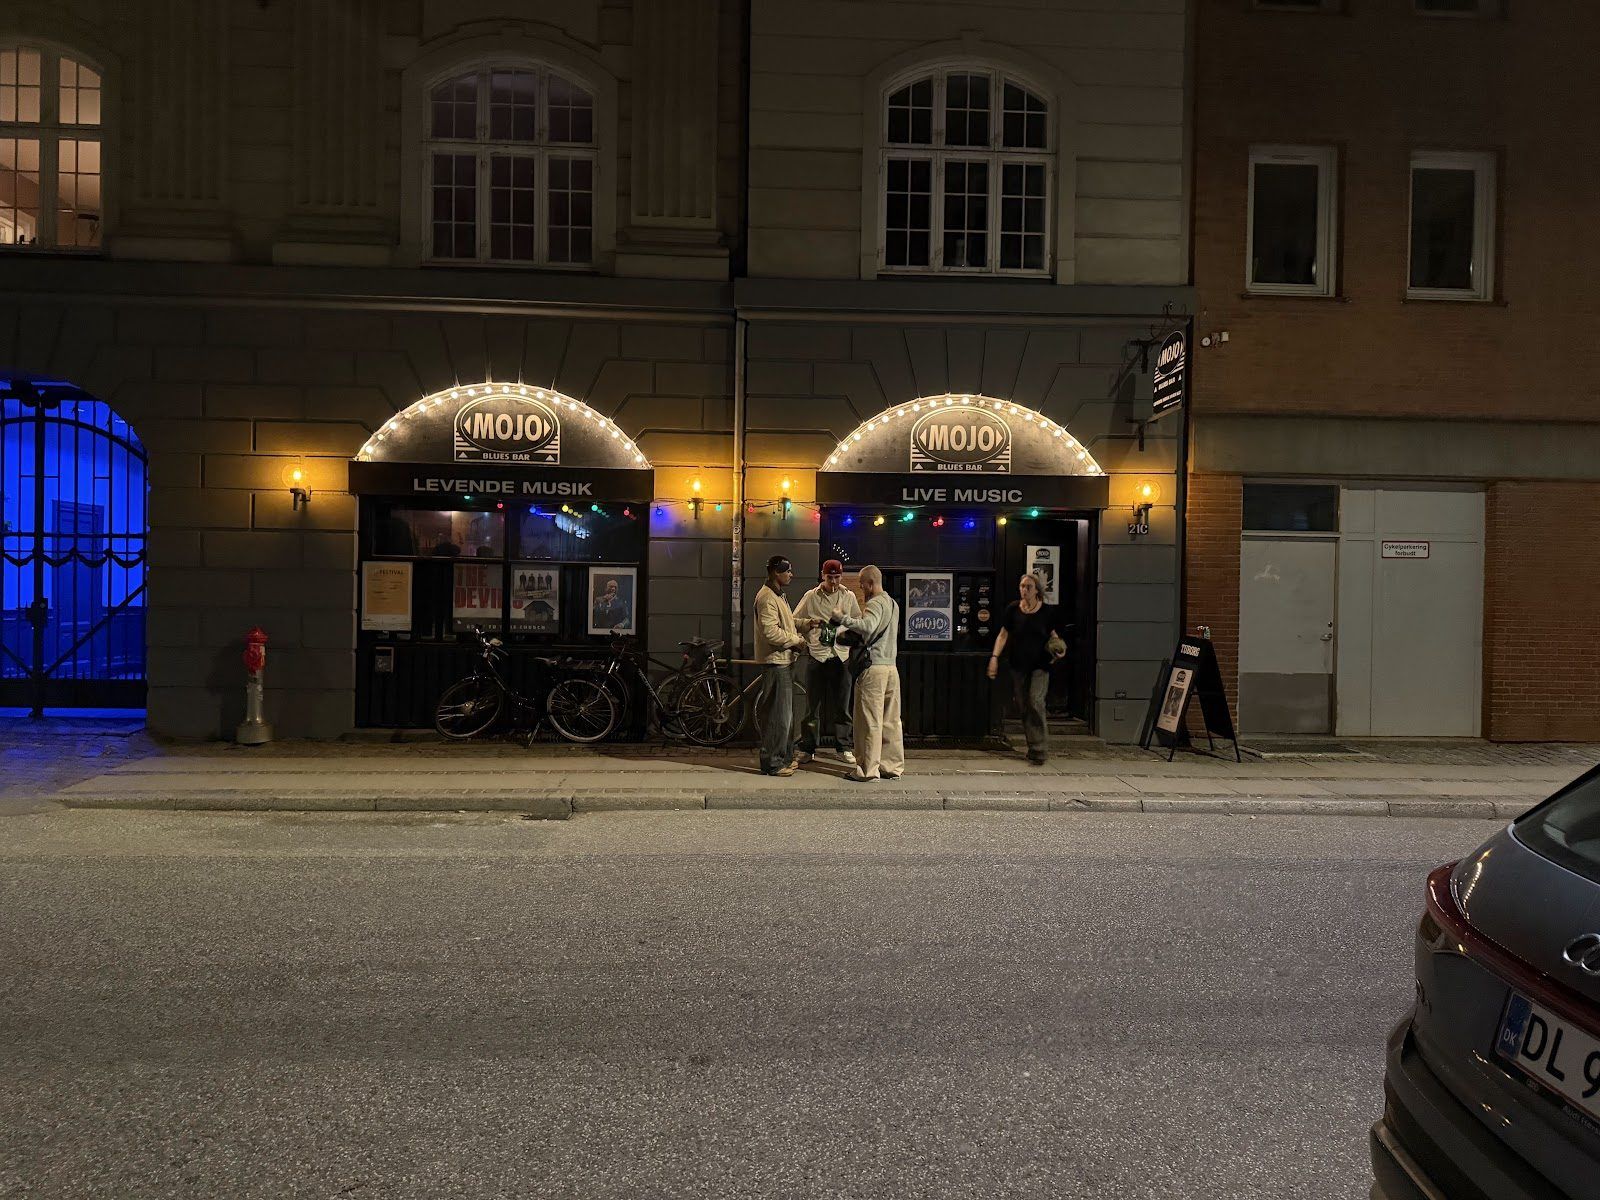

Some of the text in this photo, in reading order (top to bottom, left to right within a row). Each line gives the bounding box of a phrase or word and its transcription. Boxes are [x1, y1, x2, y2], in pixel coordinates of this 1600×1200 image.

[1160, 341, 1180, 367] MOJO
[473, 412, 543, 442] MOJO
[928, 424, 995, 452] MOJO
[482, 452, 530, 462] BLUES BAR
[937, 463, 983, 472] BLUES BAR
[413, 478, 593, 496] LEVENDE MUSIK
[902, 488, 1023, 503] LIVE MUSIC
[1129, 524, 1149, 535] 21C
[1383, 543, 1428, 551] Cykelparkering
[915, 617, 944, 630] MOJO
[1504, 1028, 1517, 1045] DK
[1521, 1013, 1564, 1081] DL
